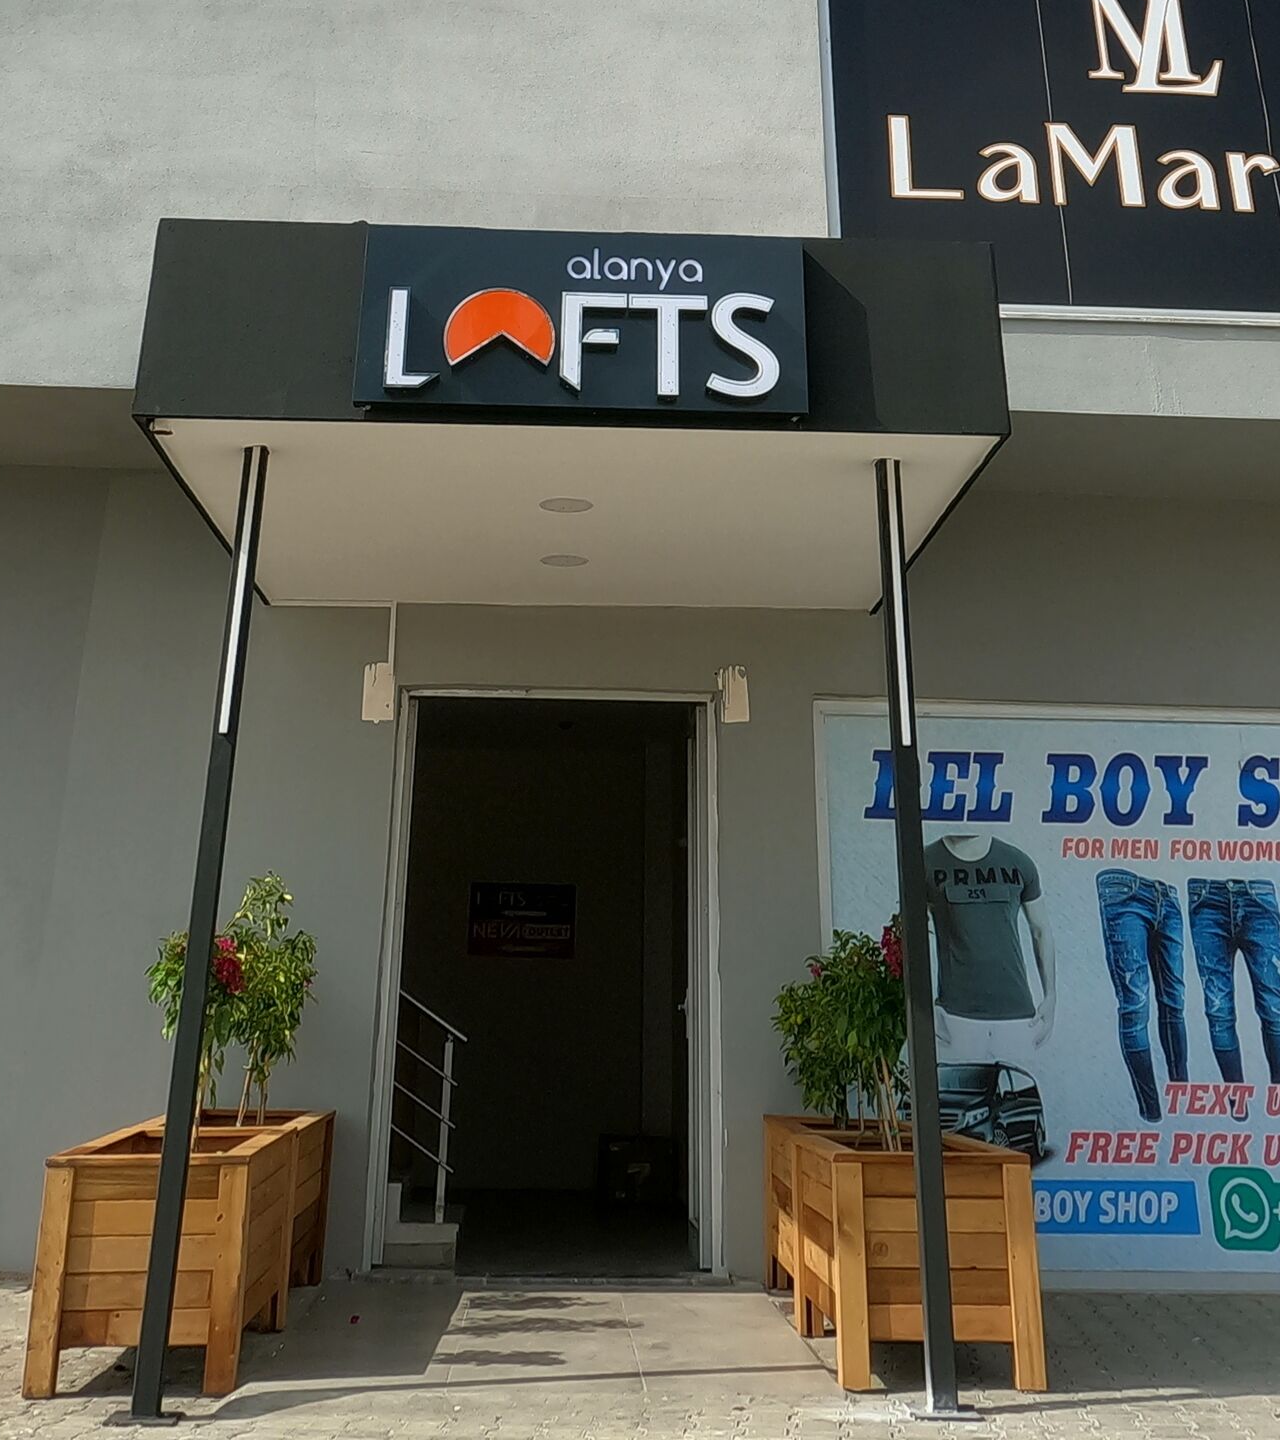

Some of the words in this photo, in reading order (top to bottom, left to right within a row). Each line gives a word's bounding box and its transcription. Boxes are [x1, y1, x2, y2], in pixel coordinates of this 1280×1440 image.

[567, 248, 703, 290] alanya
[1041, 752, 1208, 826] BOY
[1062, 838, 1105, 859] FOR
[1111, 839, 1159, 860] MEN
[1170, 839, 1212, 861] FOR
[1164, 1083, 1255, 1116] TEXT
[1065, 1132, 1160, 1164] FREE
[1169, 1133, 1252, 1165] PICK
[1034, 1190, 1093, 1224] BOY
[1099, 1190, 1179, 1224] SHOP
